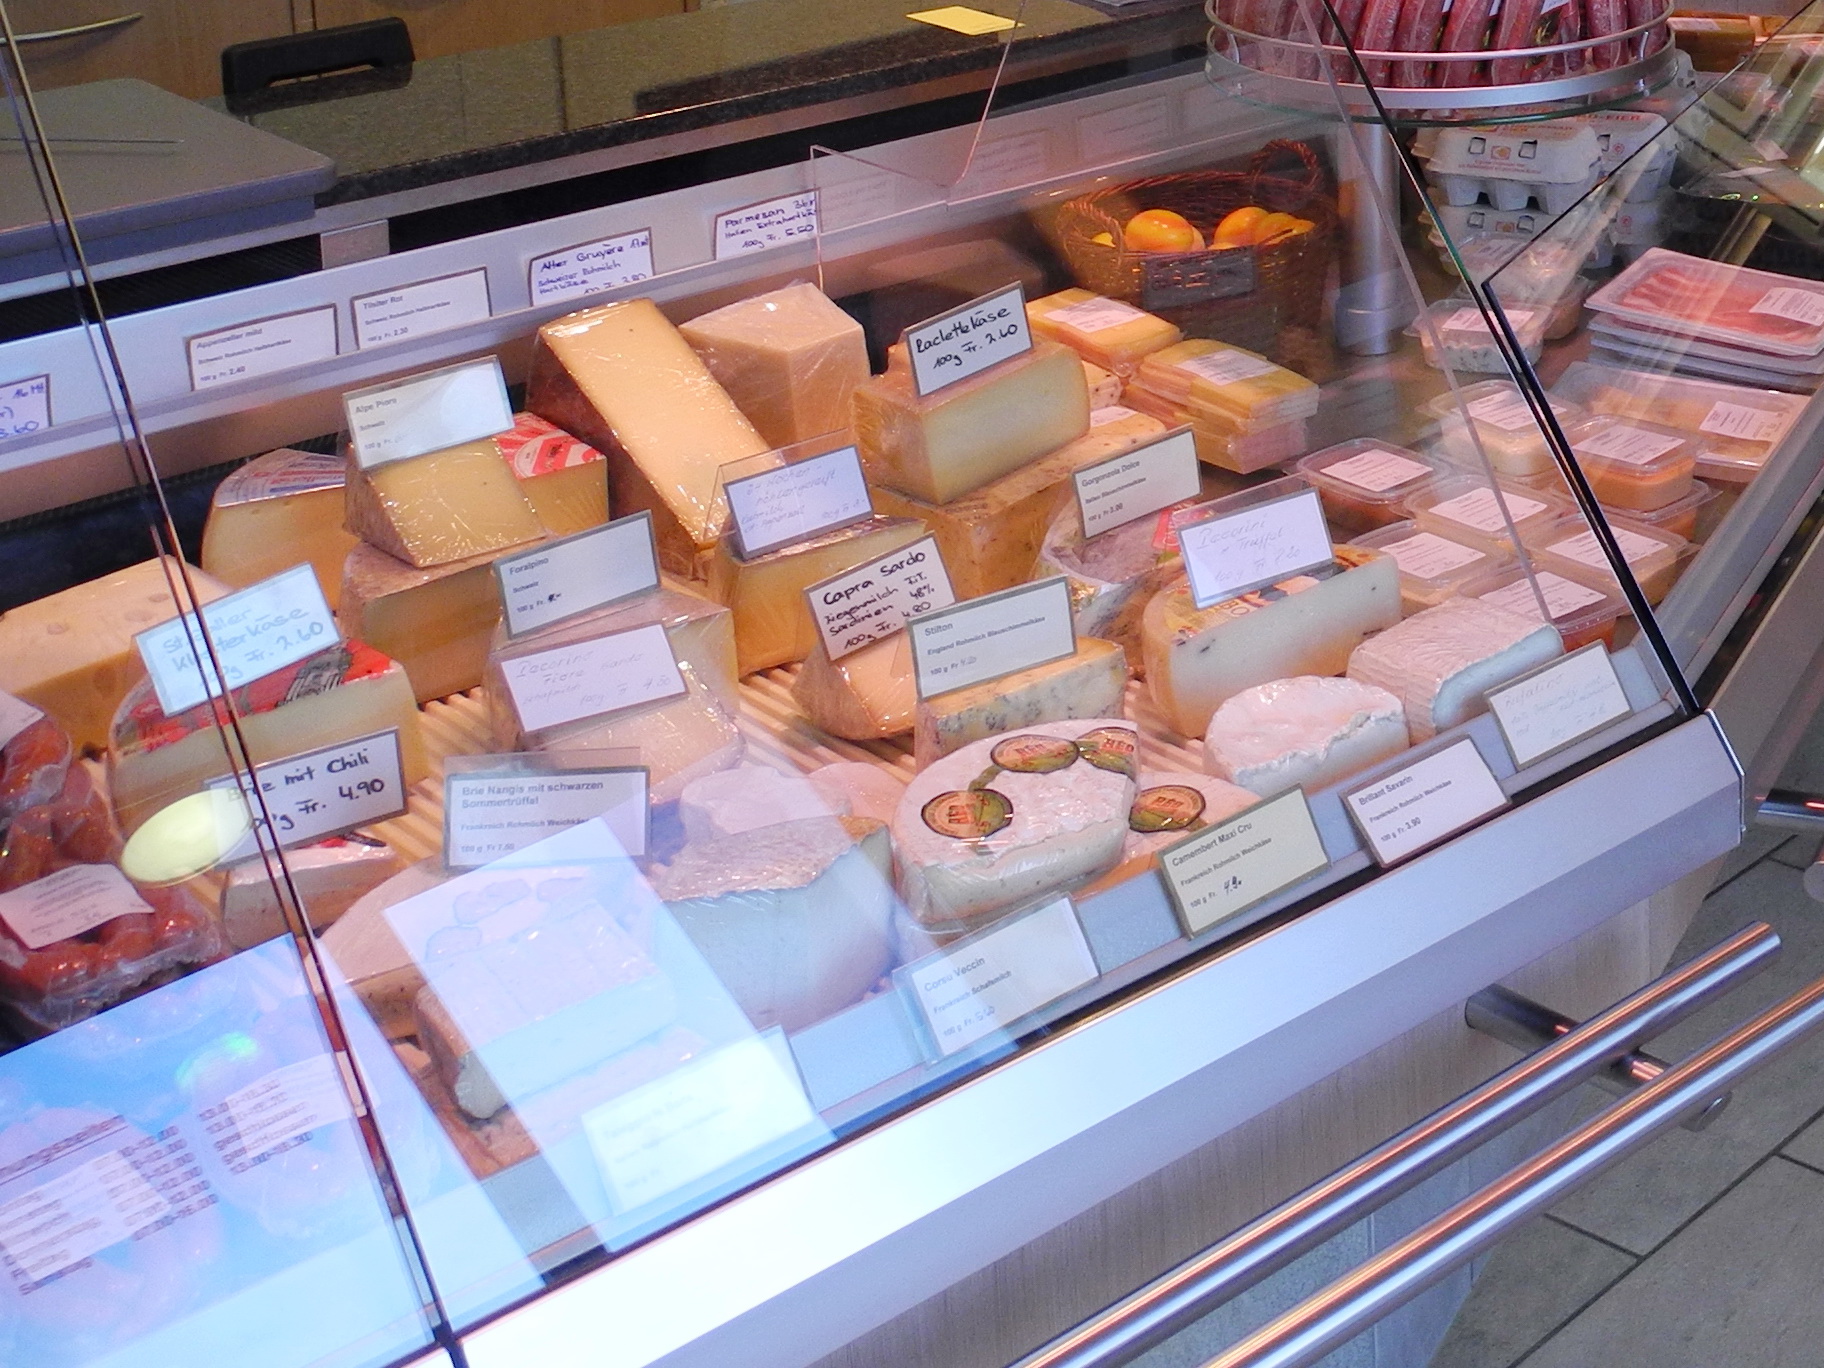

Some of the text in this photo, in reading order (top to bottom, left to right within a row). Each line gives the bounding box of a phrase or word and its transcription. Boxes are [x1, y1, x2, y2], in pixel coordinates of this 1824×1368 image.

[725, 208, 785, 229] Parmesan
[196, 328, 263, 349] Appenzeller mild
[933, 354, 963, 370] 100g
[961, 341, 983, 353] Fr.
[1081, 461, 1141, 487] Gorgonzola Dolce
[509, 557, 549, 576] Foralpino
[823, 552, 926, 606] Capra Sardo
[924, 622, 953, 637] Stilton
[927, 642, 954, 656] England
[955, 633, 987, 647] Rohmilch
[285, 766, 315, 785] mit
[327, 748, 370, 774] Chili
[295, 778, 385, 815] Fr. 4.90
[462, 781, 604, 797] Brie Nangis mit schwarzen
[1358, 775, 1414, 806] Brillant Savarin
[1171, 822, 1253, 867] Camembert Maxi Cru
